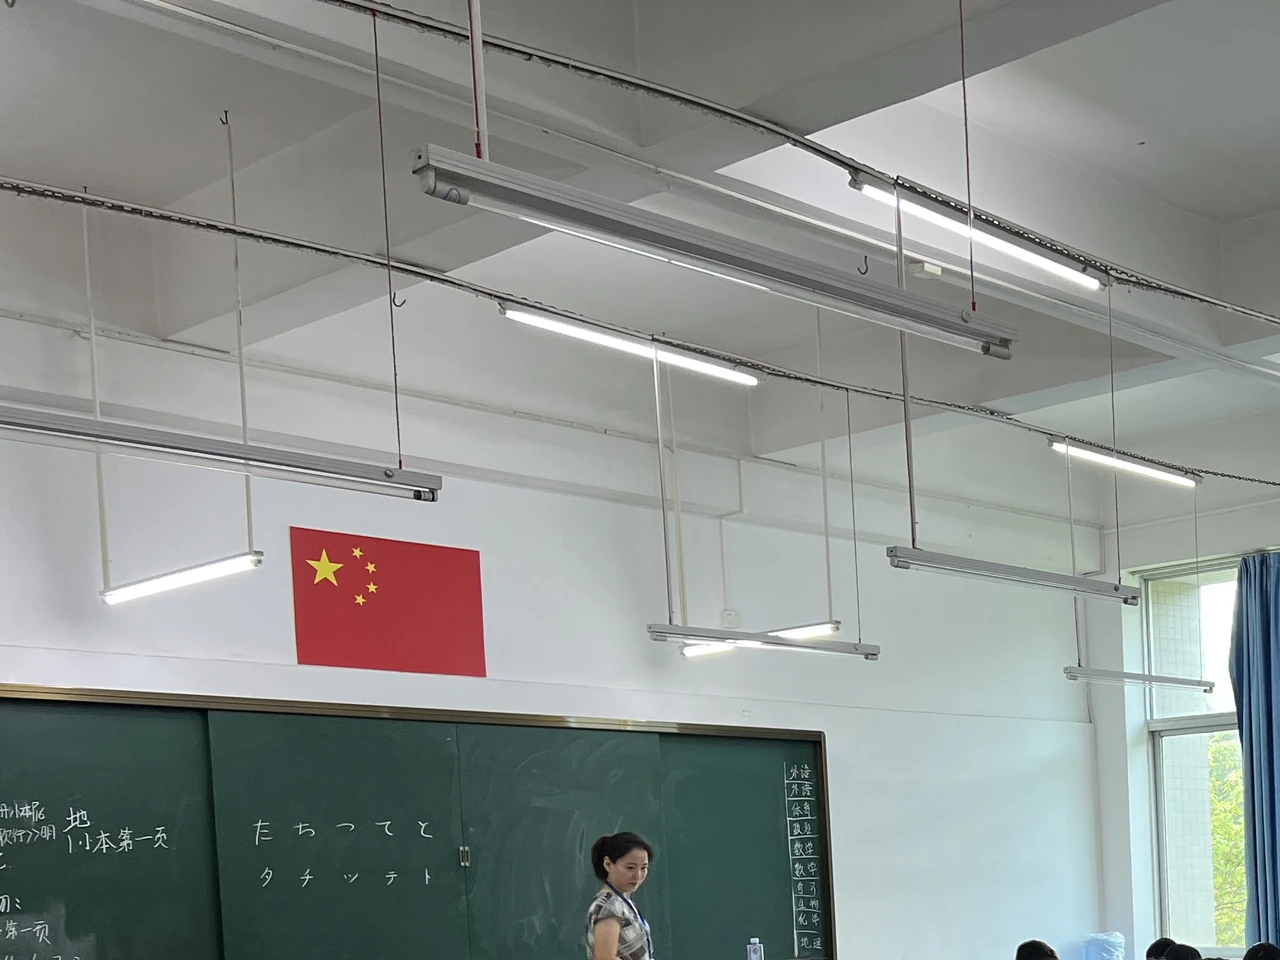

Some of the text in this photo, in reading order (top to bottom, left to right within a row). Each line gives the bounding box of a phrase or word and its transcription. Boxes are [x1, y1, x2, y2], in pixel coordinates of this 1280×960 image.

[793, 840, 814, 857] 数学
[794, 861, 818, 877] 数学
[0, 920, 51, 945] 第一页
